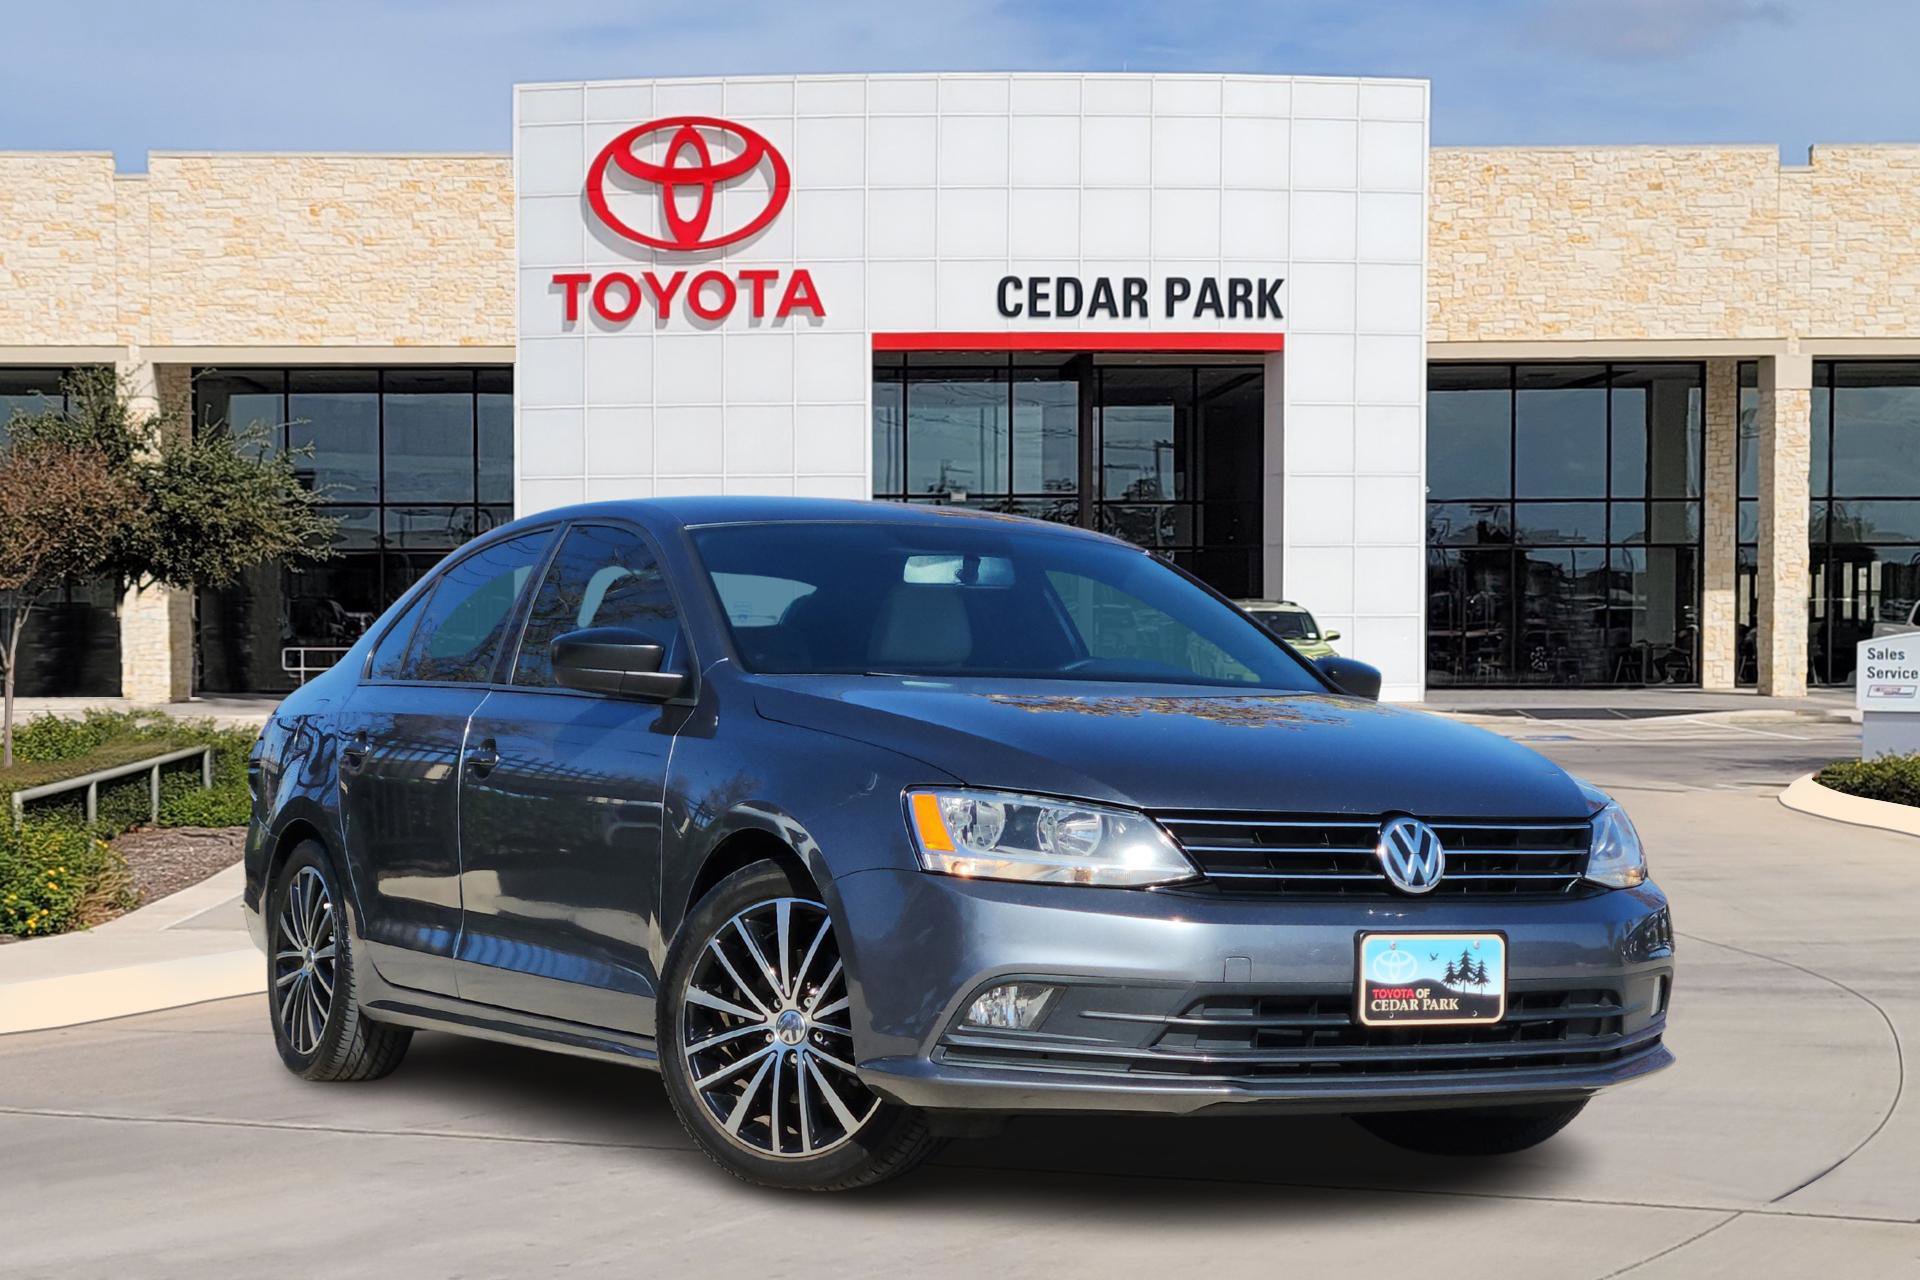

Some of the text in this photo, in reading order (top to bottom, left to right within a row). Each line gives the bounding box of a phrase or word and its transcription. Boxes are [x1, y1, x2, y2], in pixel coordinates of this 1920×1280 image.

[552, 269, 826, 322] TOYOTA
[997, 275, 1285, 319] CEDAR PARK
[1867, 647, 1905, 661] Sales
[1867, 666, 1919, 680] Service
[1372, 988, 1431, 999] TOYOTA OF
[1371, 998, 1459, 1011] CEDAR PARK
